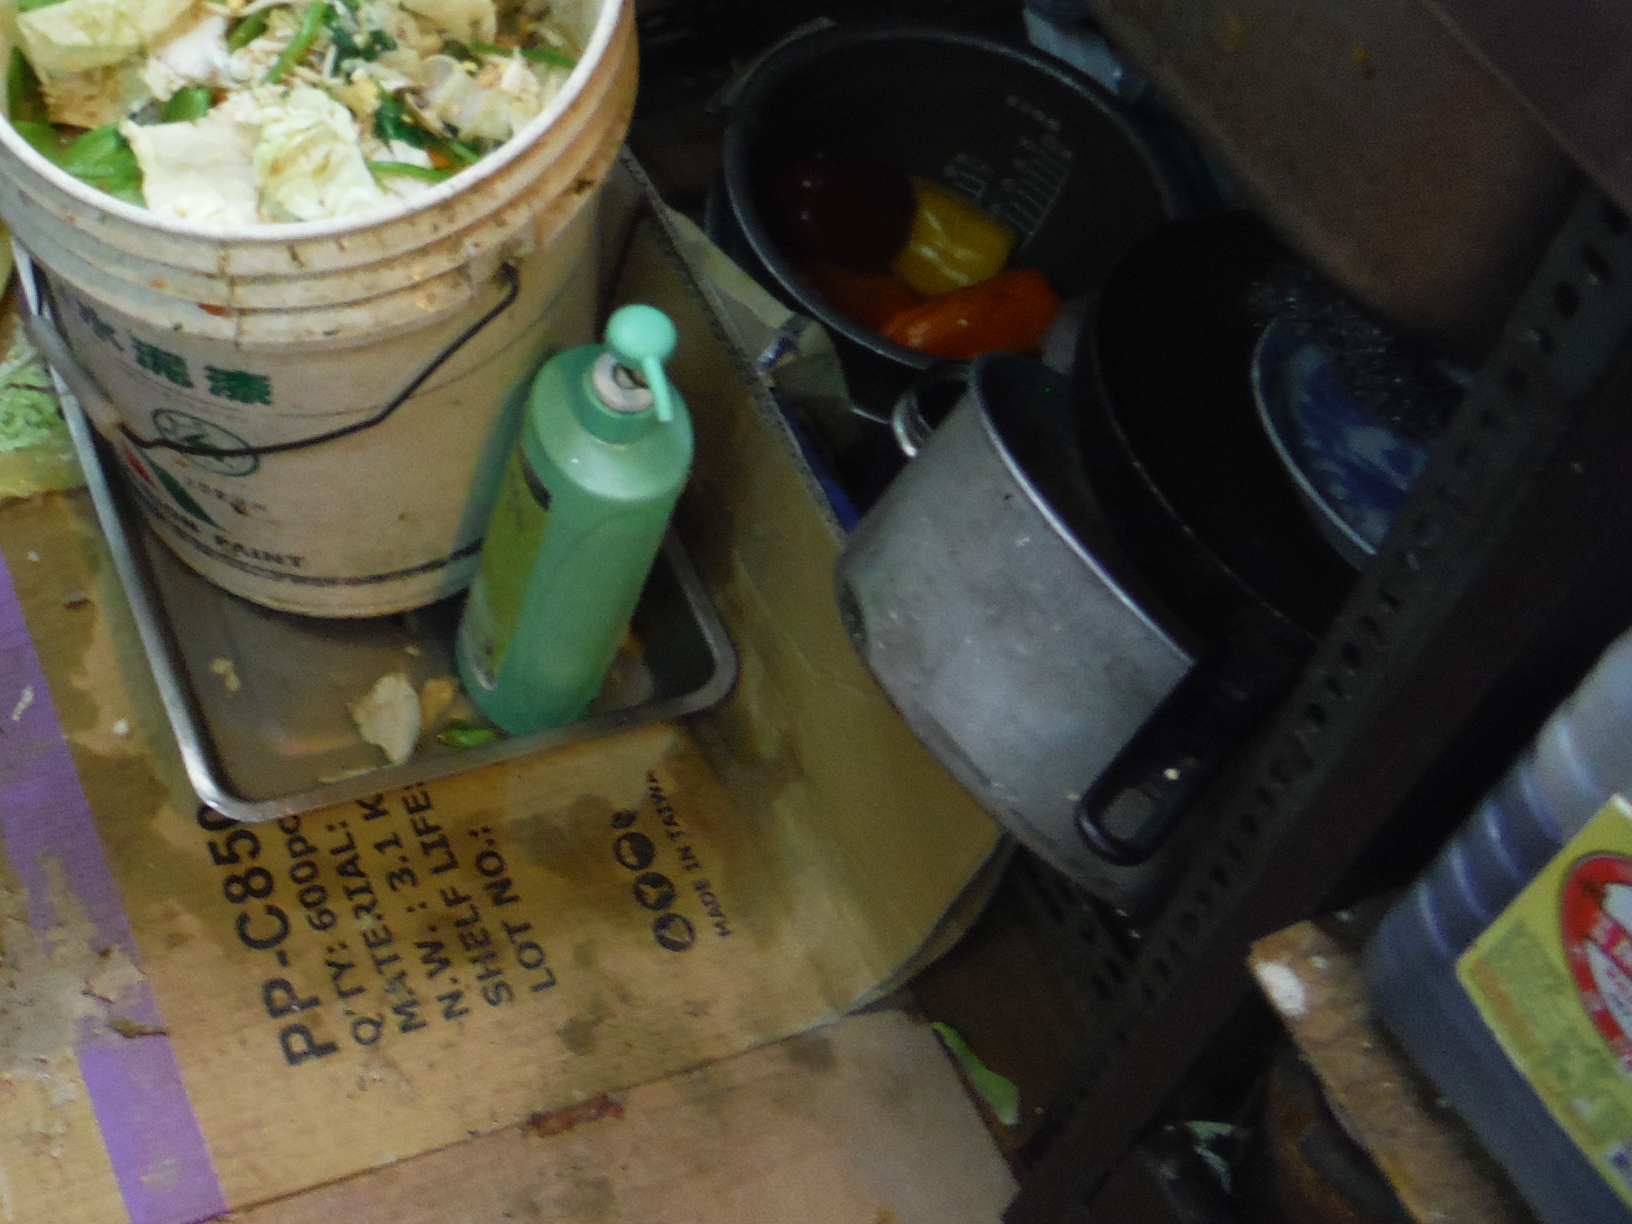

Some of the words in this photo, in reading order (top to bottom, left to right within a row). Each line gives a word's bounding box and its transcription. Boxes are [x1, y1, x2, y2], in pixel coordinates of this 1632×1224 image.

[373, 832, 419, 892] 3.1
[402, 781, 460, 875] LIFE:
[676, 842, 702, 873] IN
[328, 819, 428, 1035] MATERIAL:
[691, 876, 734, 938] MADE
[441, 887, 515, 1007] SHELF
[502, 922, 557, 993] LOT
